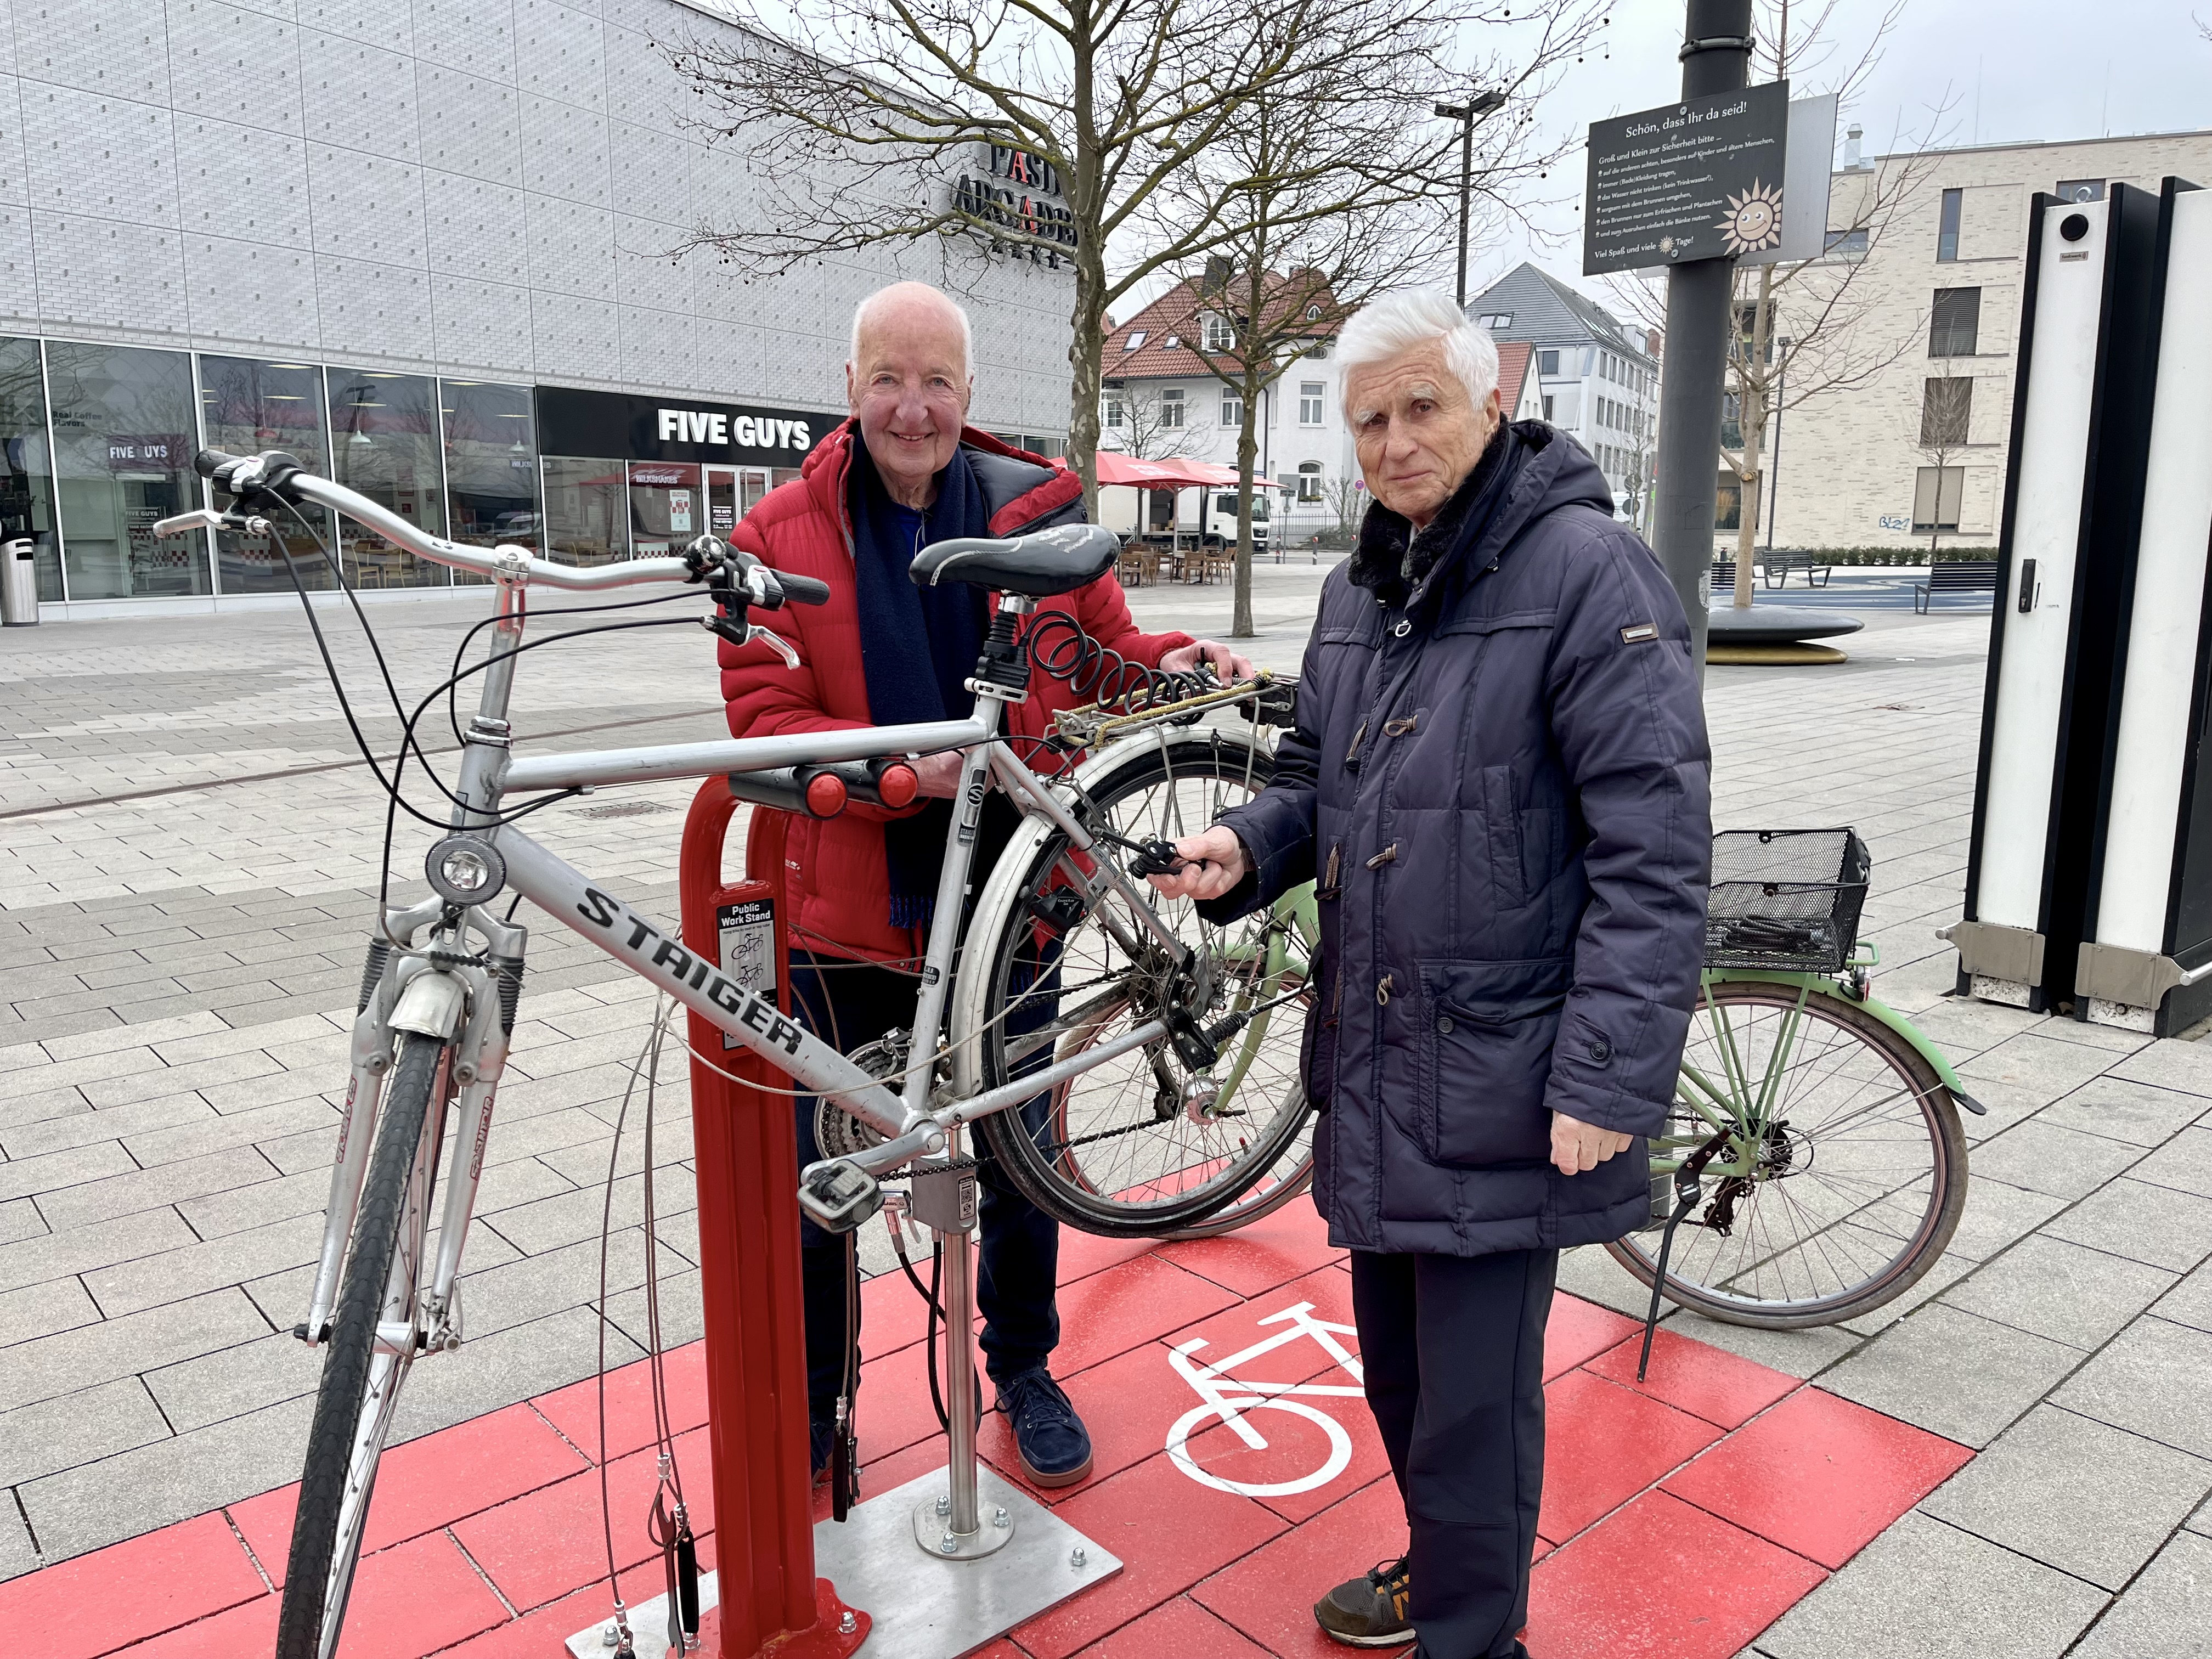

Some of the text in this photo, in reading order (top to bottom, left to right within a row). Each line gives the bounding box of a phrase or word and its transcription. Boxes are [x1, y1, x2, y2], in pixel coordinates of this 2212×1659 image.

[1626, 101, 1747, 138] Schön, dass Ihr da seid!
[1599, 154, 1616, 165] Groß
[1617, 151, 1630, 161] und
[1631, 148, 1648, 158] Klein
[1662, 138, 1696, 152] Sicherheit
[1697, 136, 1714, 144] bitte
[1620, 165, 1640, 173] anderen
[1661, 155, 1686, 165] besonders
[1716, 145, 1727, 154] und
[1745, 138, 1774, 148] Menschen,
[1662, 182, 1676, 190] (kein
[1601, 205, 1621, 213] sorgsam
[1644, 197, 1666, 205] Brunnen
[1655, 206, 1681, 215] Erfrischen
[1675, 236, 1694, 246] Tage!
[1595, 242, 1656, 258] Viel Spaß und viele
[658, 409, 810, 451] FIVE GUYS
[110, 446, 136, 459] FIVE
[732, 903, 760, 916] Public
[721, 910, 770, 927] Work Stand
[577, 887, 803, 1055] STAIGER
